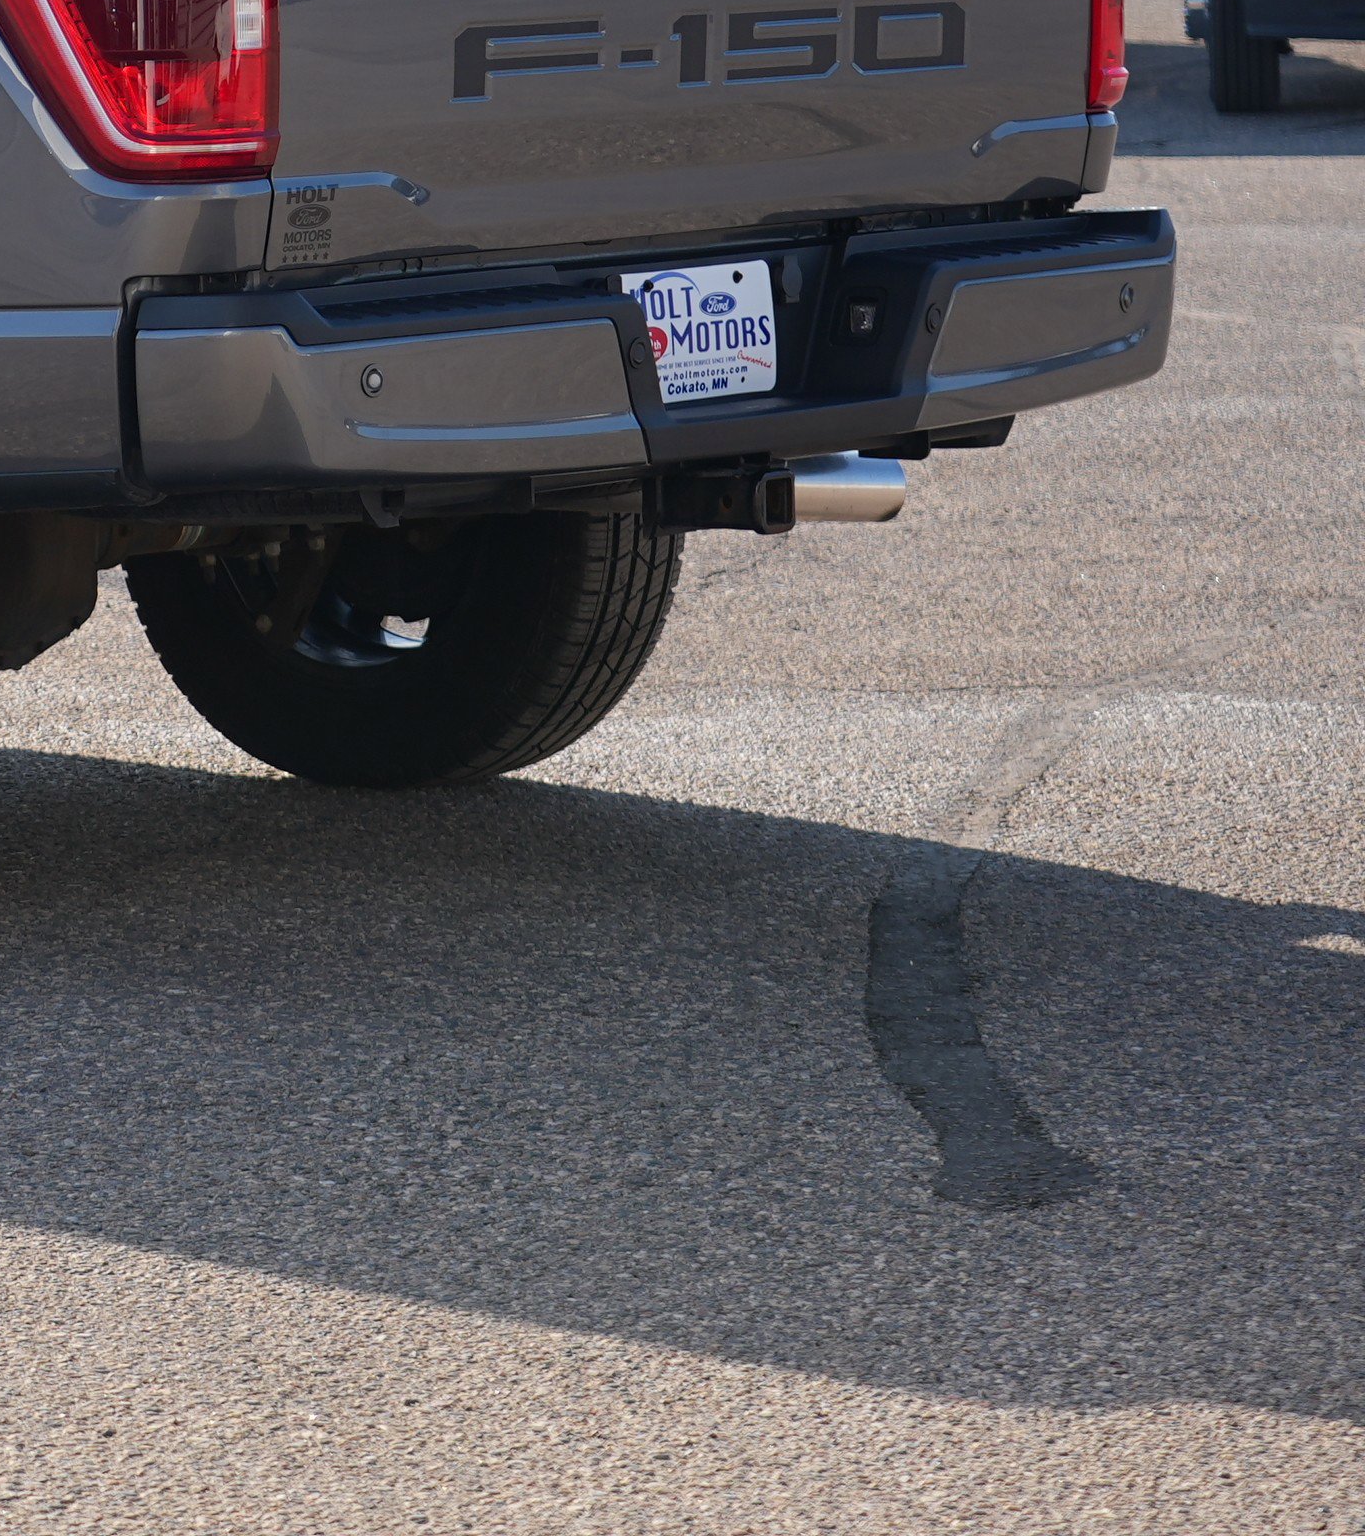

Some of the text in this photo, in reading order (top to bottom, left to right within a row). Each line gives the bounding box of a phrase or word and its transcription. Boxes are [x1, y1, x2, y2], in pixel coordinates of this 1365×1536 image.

[449, 1, 968, 103] F-150
[286, 183, 339, 205] HOLT
[283, 229, 332, 244] MOTORS
[670, 315, 771, 356] MOTORS
[667, 377, 729, 396] Cokato, MN
